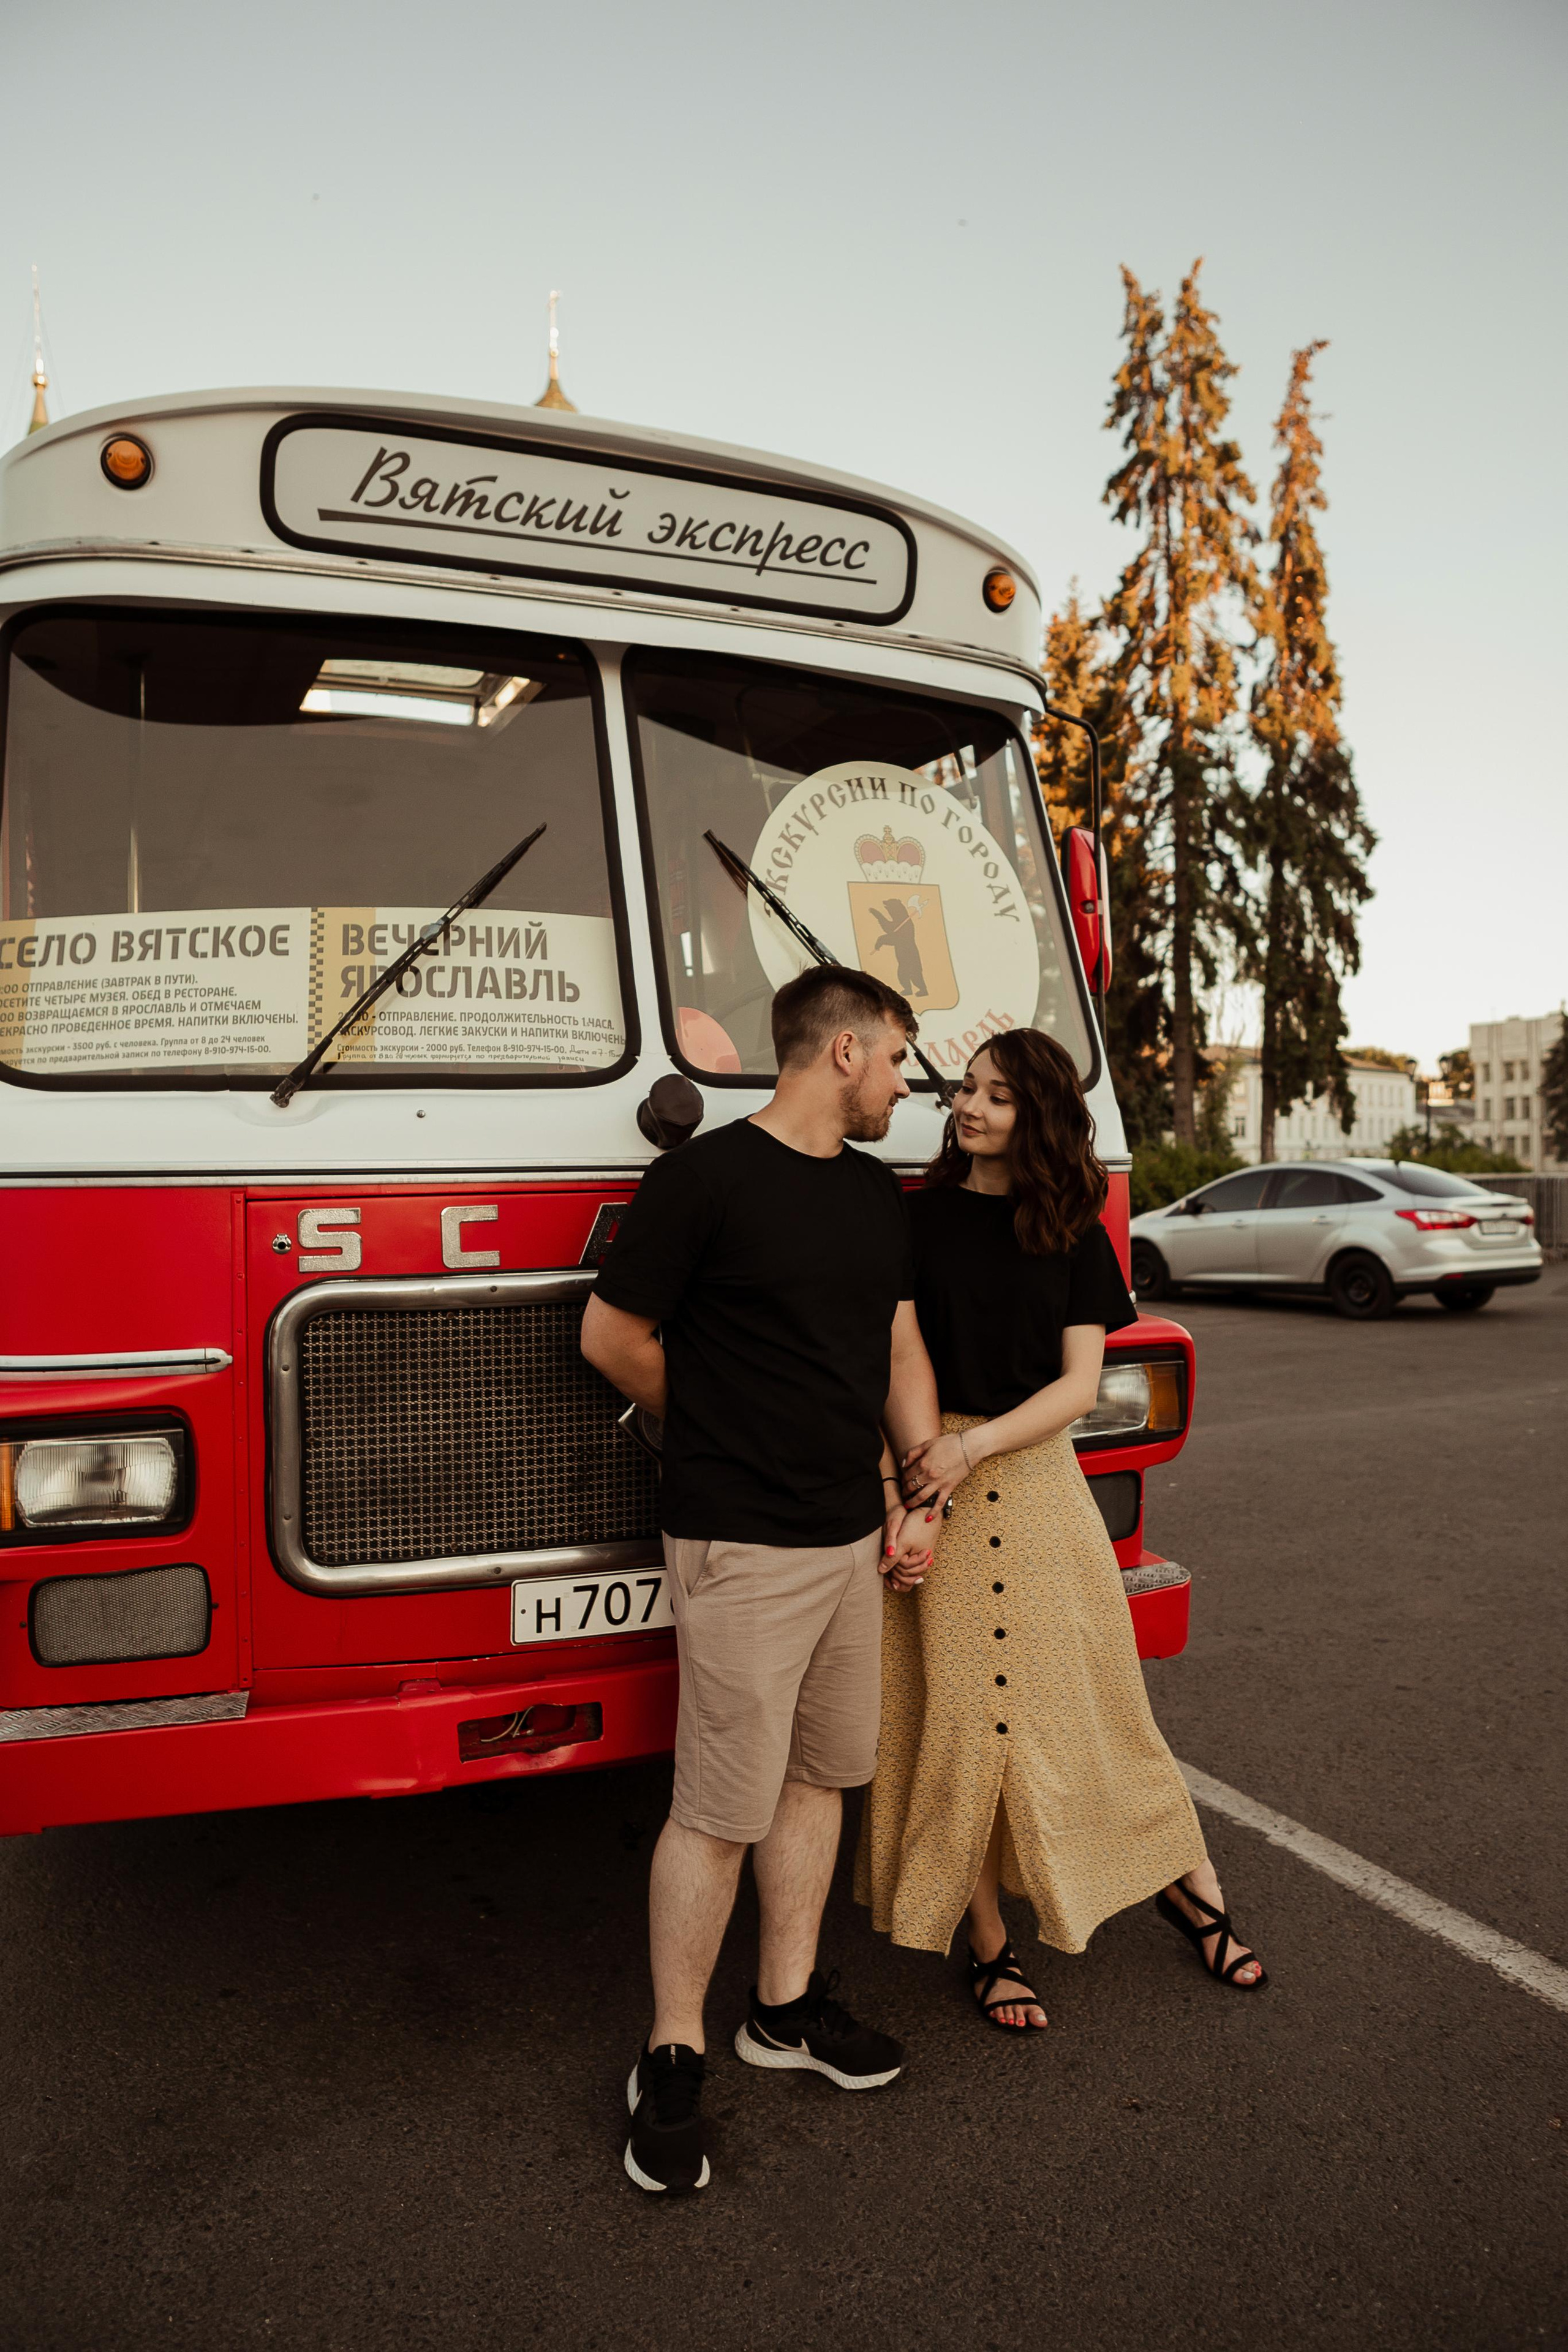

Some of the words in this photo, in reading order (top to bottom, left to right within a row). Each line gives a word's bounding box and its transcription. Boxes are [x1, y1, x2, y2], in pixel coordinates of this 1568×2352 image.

[350, 447, 630, 537] Вятский
[647, 512, 870, 576] экспресс
[898, 781, 936, 815] ПО
[940, 807, 1021, 923] ГОРОДУ
[0, 932, 96, 969] СЕЛО
[111, 924, 290, 963] ВЯТСКОЕ
[22, 978, 98, 992] ОТПРАВЛЕНИЕ
[101, 976, 152, 989] (ЗАВТРАК
[154, 976, 161, 985] В
[164, 974, 198, 985] ПУТИ).
[44, 993, 86, 1006] ЧЕТЫРЕ
[89, 991, 129, 1003] МУЗЕЯ.
[132, 989, 161, 1001] ОБЕД
[164, 989, 171, 999] В
[174, 987, 238, 999] РЕСТОРАНЕ.
[18, 1006, 108, 1022] ВОЗВРАЩАЕМСЯ
[111, 1005, 118, 1016] В
[122, 1002, 186, 1015] ЯРОСЛАВЛЬ
[190, 1001, 197, 1012] И
[200, 1000, 262, 1012] ОТМЕЧАЕМ
[379, 1011, 457, 1022] ОТПРАВЛЕНИЕ.
[459, 1012, 579, 1026] ПРОДОЛЖИТЕЛЬНОСТЬ
[51, 1019, 131, 1034] ПРОВЕДЕННОЕ
[134, 1017, 175, 1029] ВРЕМЯ.
[178, 1015, 229, 1027] НАПИТКИ
[232, 1013, 299, 1026] ВКЛЮЧЕНЫ.
[338, 1025, 417, 1038] СКУРСОВОД.
[420, 1027, 459, 1036] ЛЕГКИЕ
[462, 1027, 508, 1036] ЗАКУСКИ
[511, 1027, 518, 1036] И
[521, 1027, 568, 1039] НАПИТКИ
[73, 1042, 93, 1050] 3500
[160, 1038, 187, 1047] Группа
[380, 1045, 419, 1054] экскурсии
[450, 1044, 465, 1053] руб.
[467, 1044, 501, 1054] Телефон
